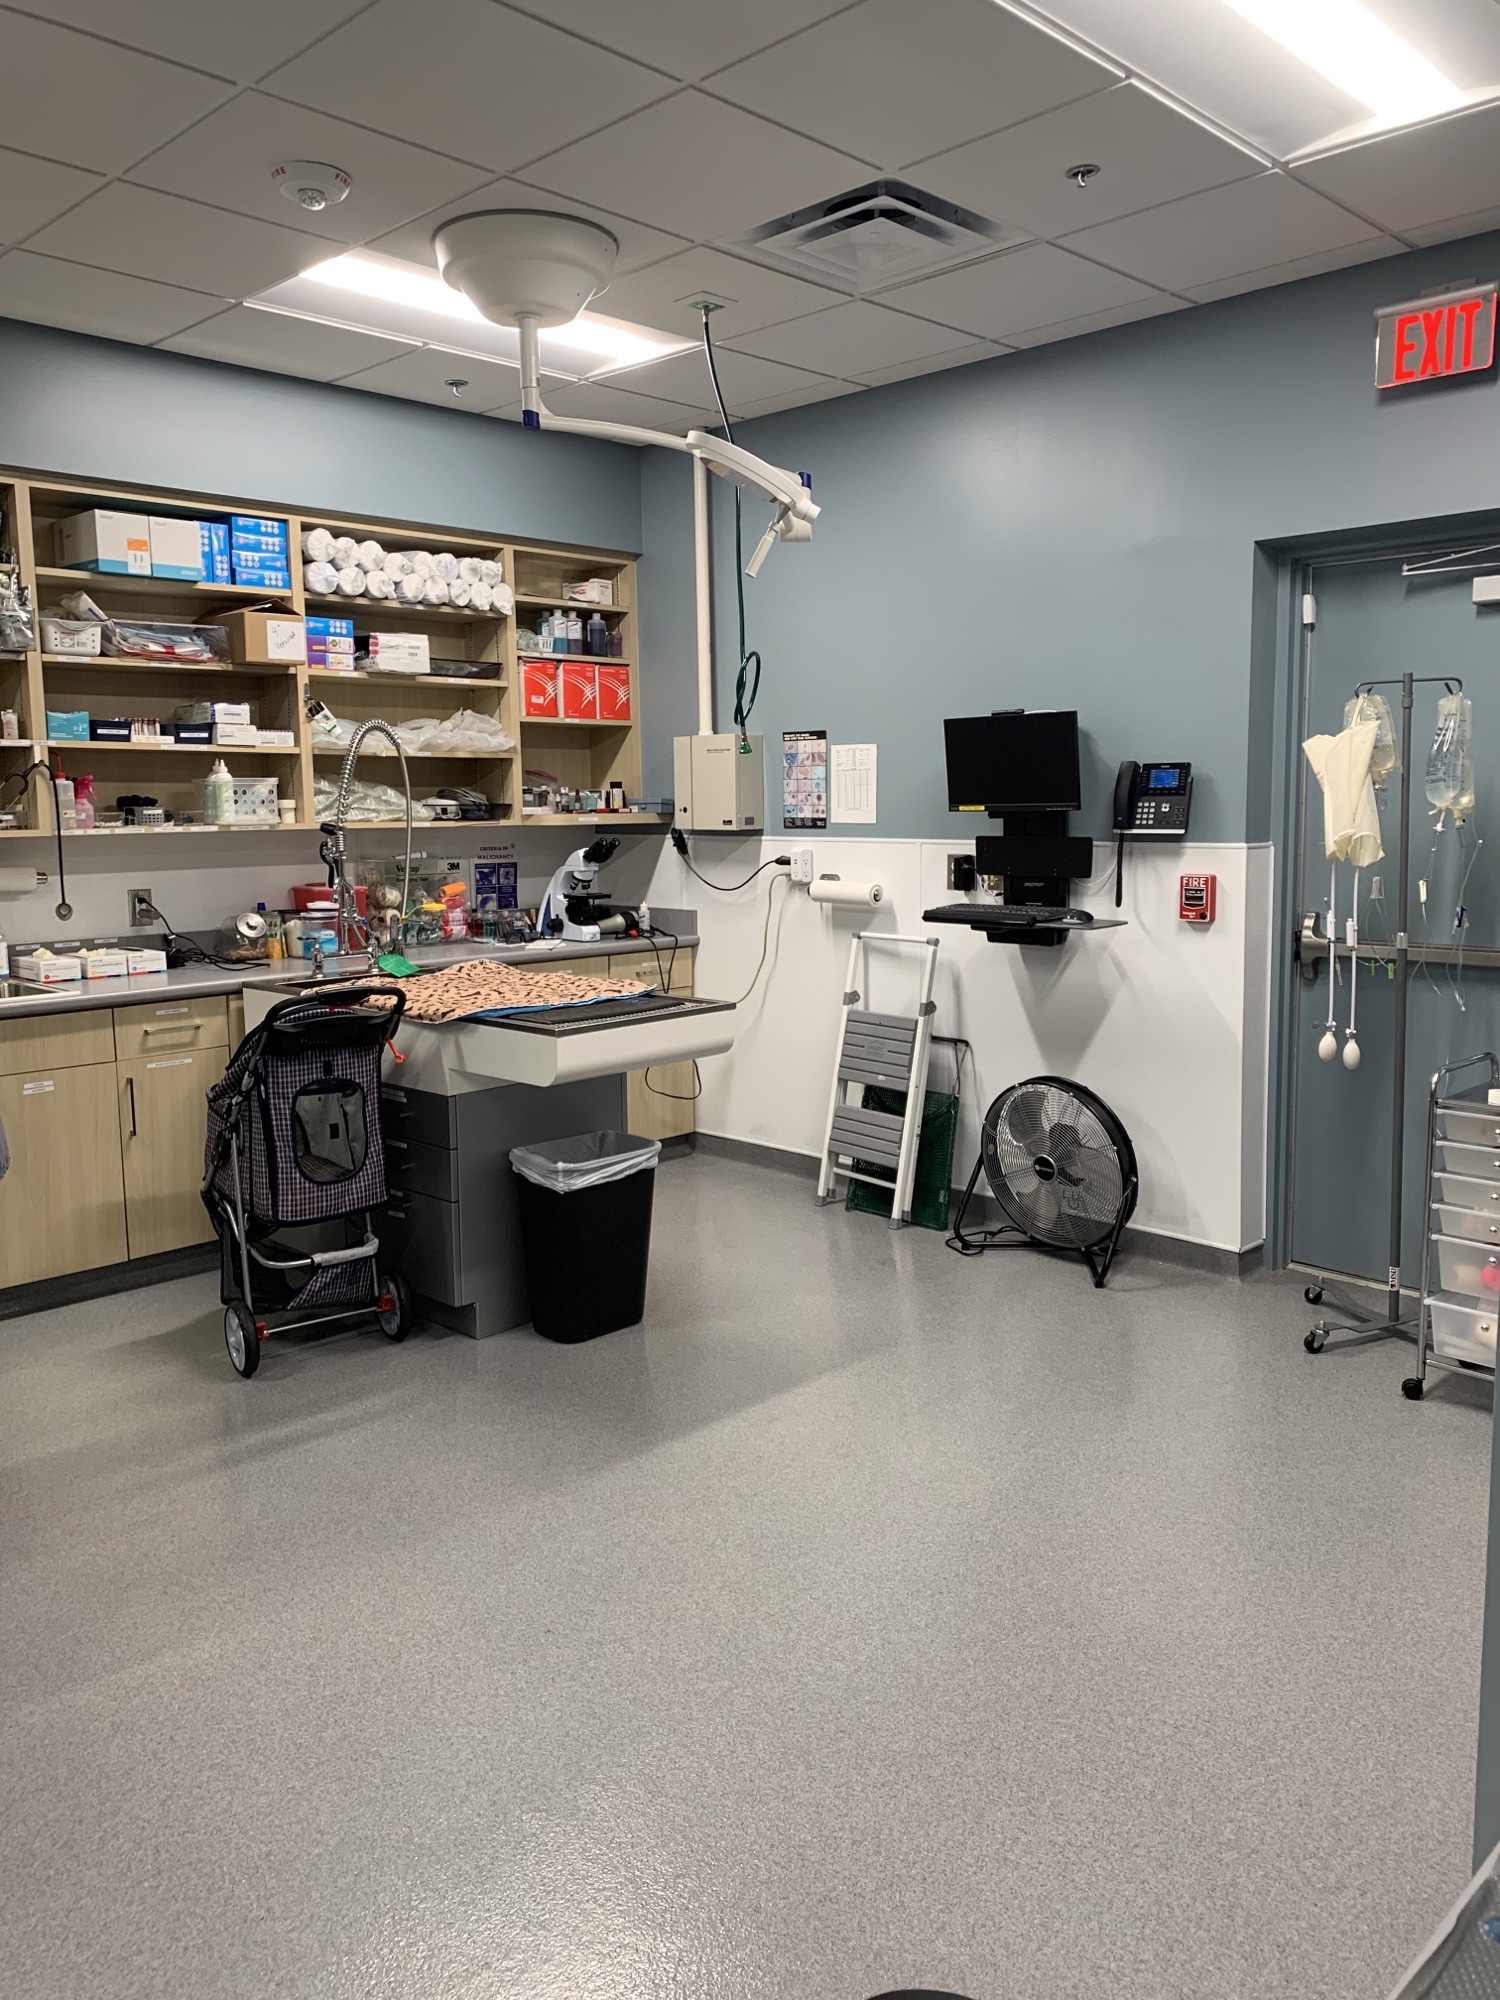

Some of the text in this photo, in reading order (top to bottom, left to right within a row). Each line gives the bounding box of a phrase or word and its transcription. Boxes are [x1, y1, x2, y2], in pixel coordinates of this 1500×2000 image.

[1393, 300, 1483, 382] EXIT
[447, 862, 460, 871] 3M
[1182, 877, 1207, 888] FIRE
